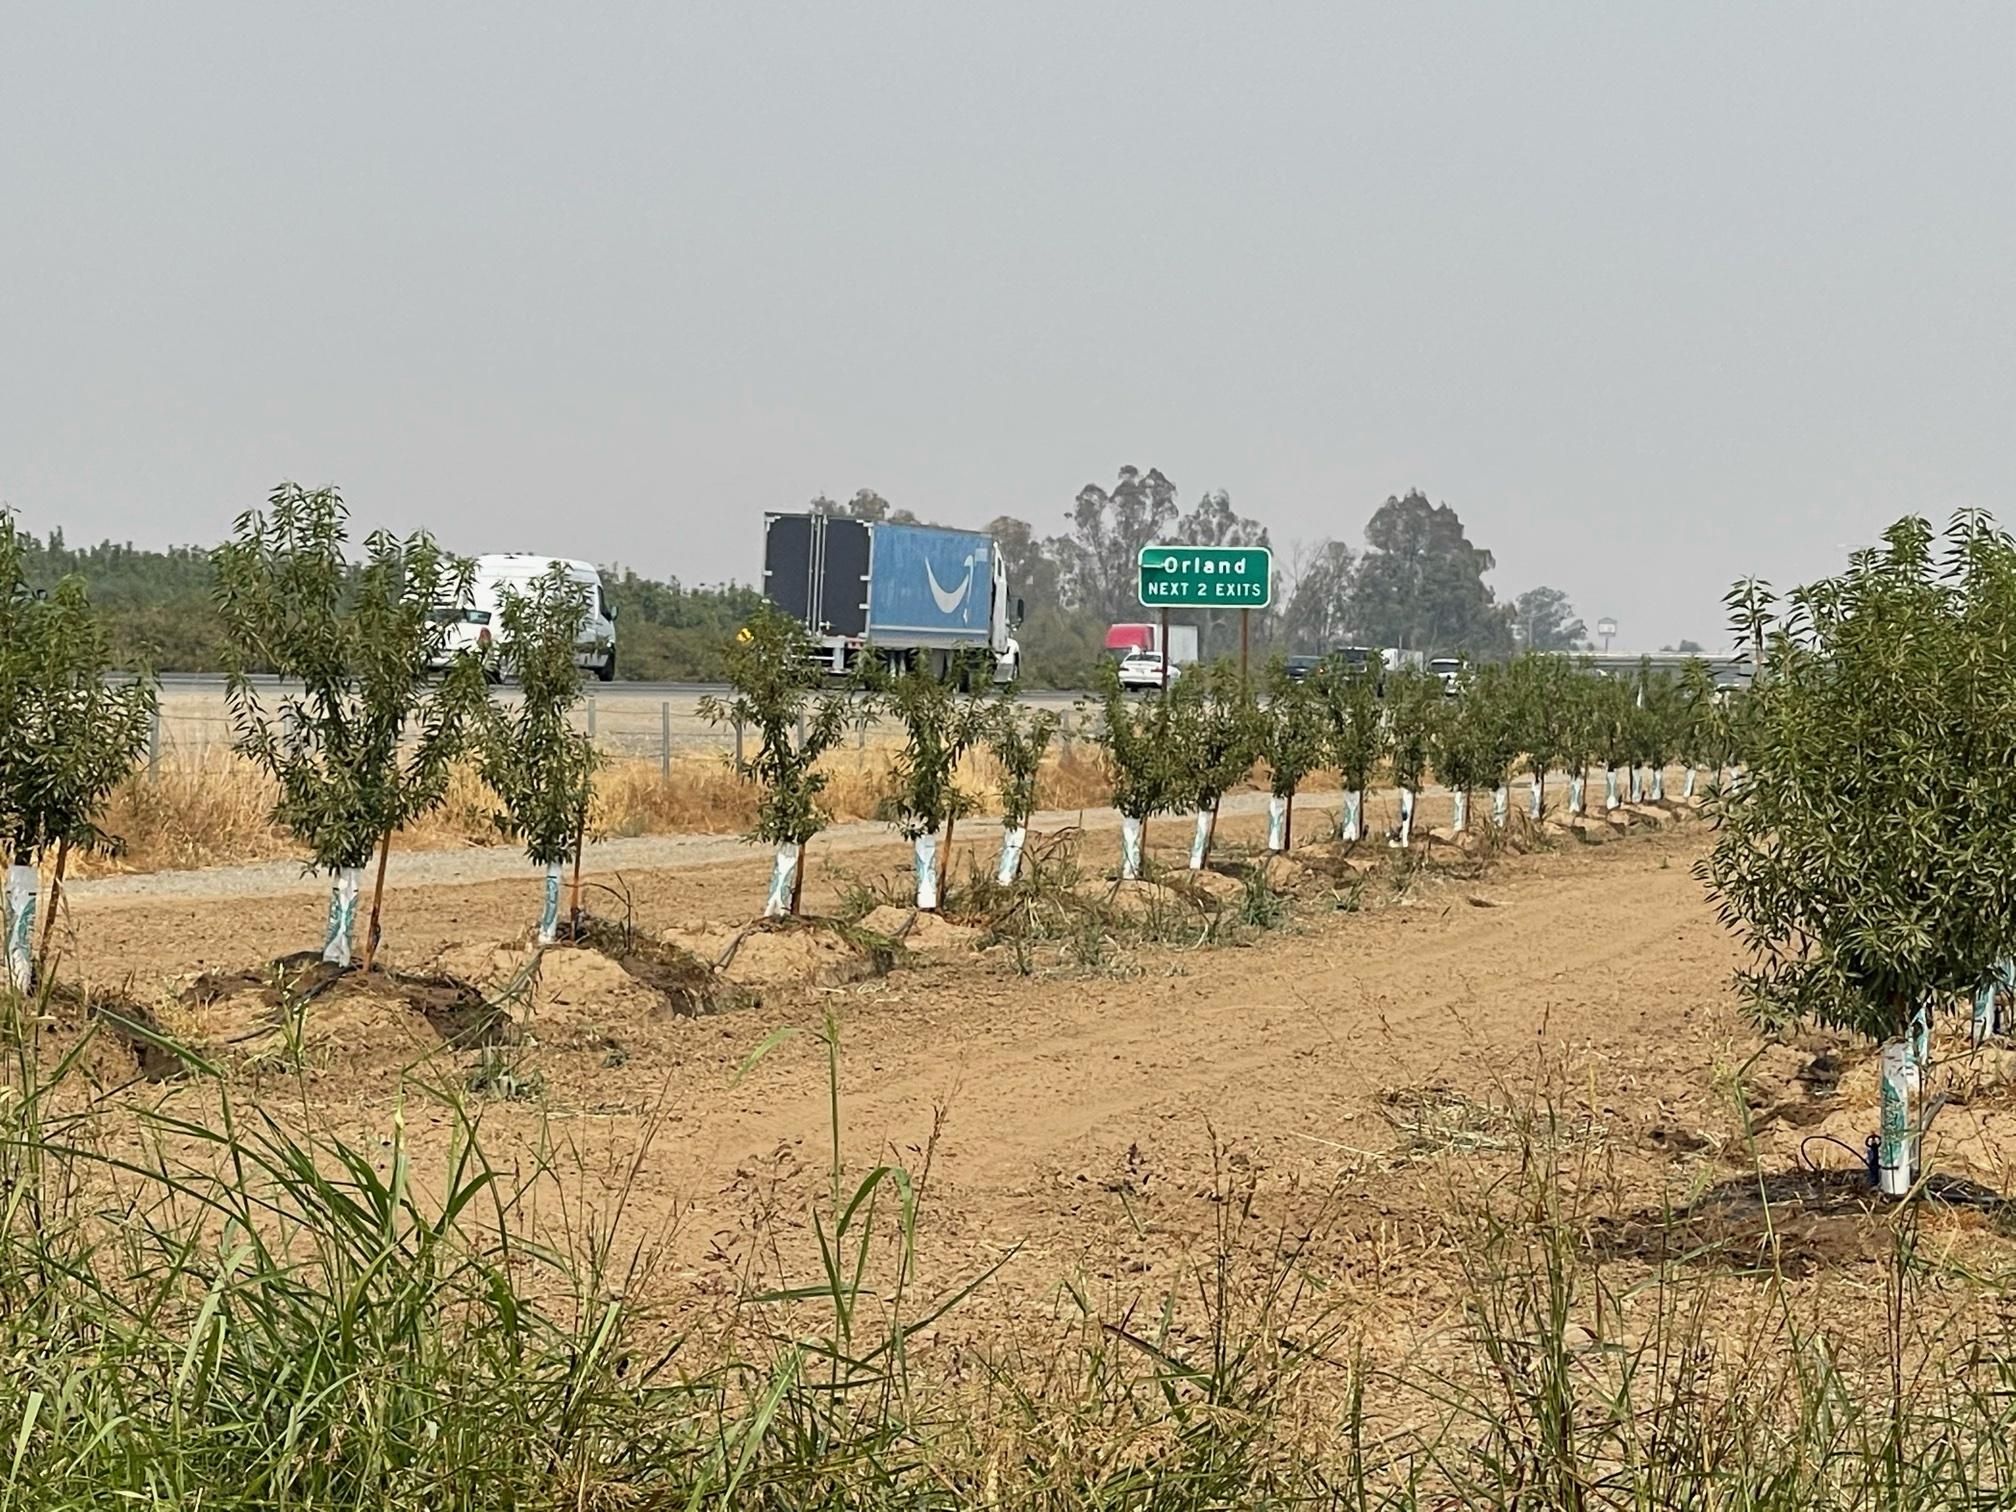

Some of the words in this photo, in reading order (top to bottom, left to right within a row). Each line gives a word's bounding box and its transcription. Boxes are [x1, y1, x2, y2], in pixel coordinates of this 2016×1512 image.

[1164, 556, 1246, 574] Orland
[1148, 582, 1189, 596] NEXT
[1197, 583, 1208, 596] 2
[1215, 583, 1261, 597] EXITS
